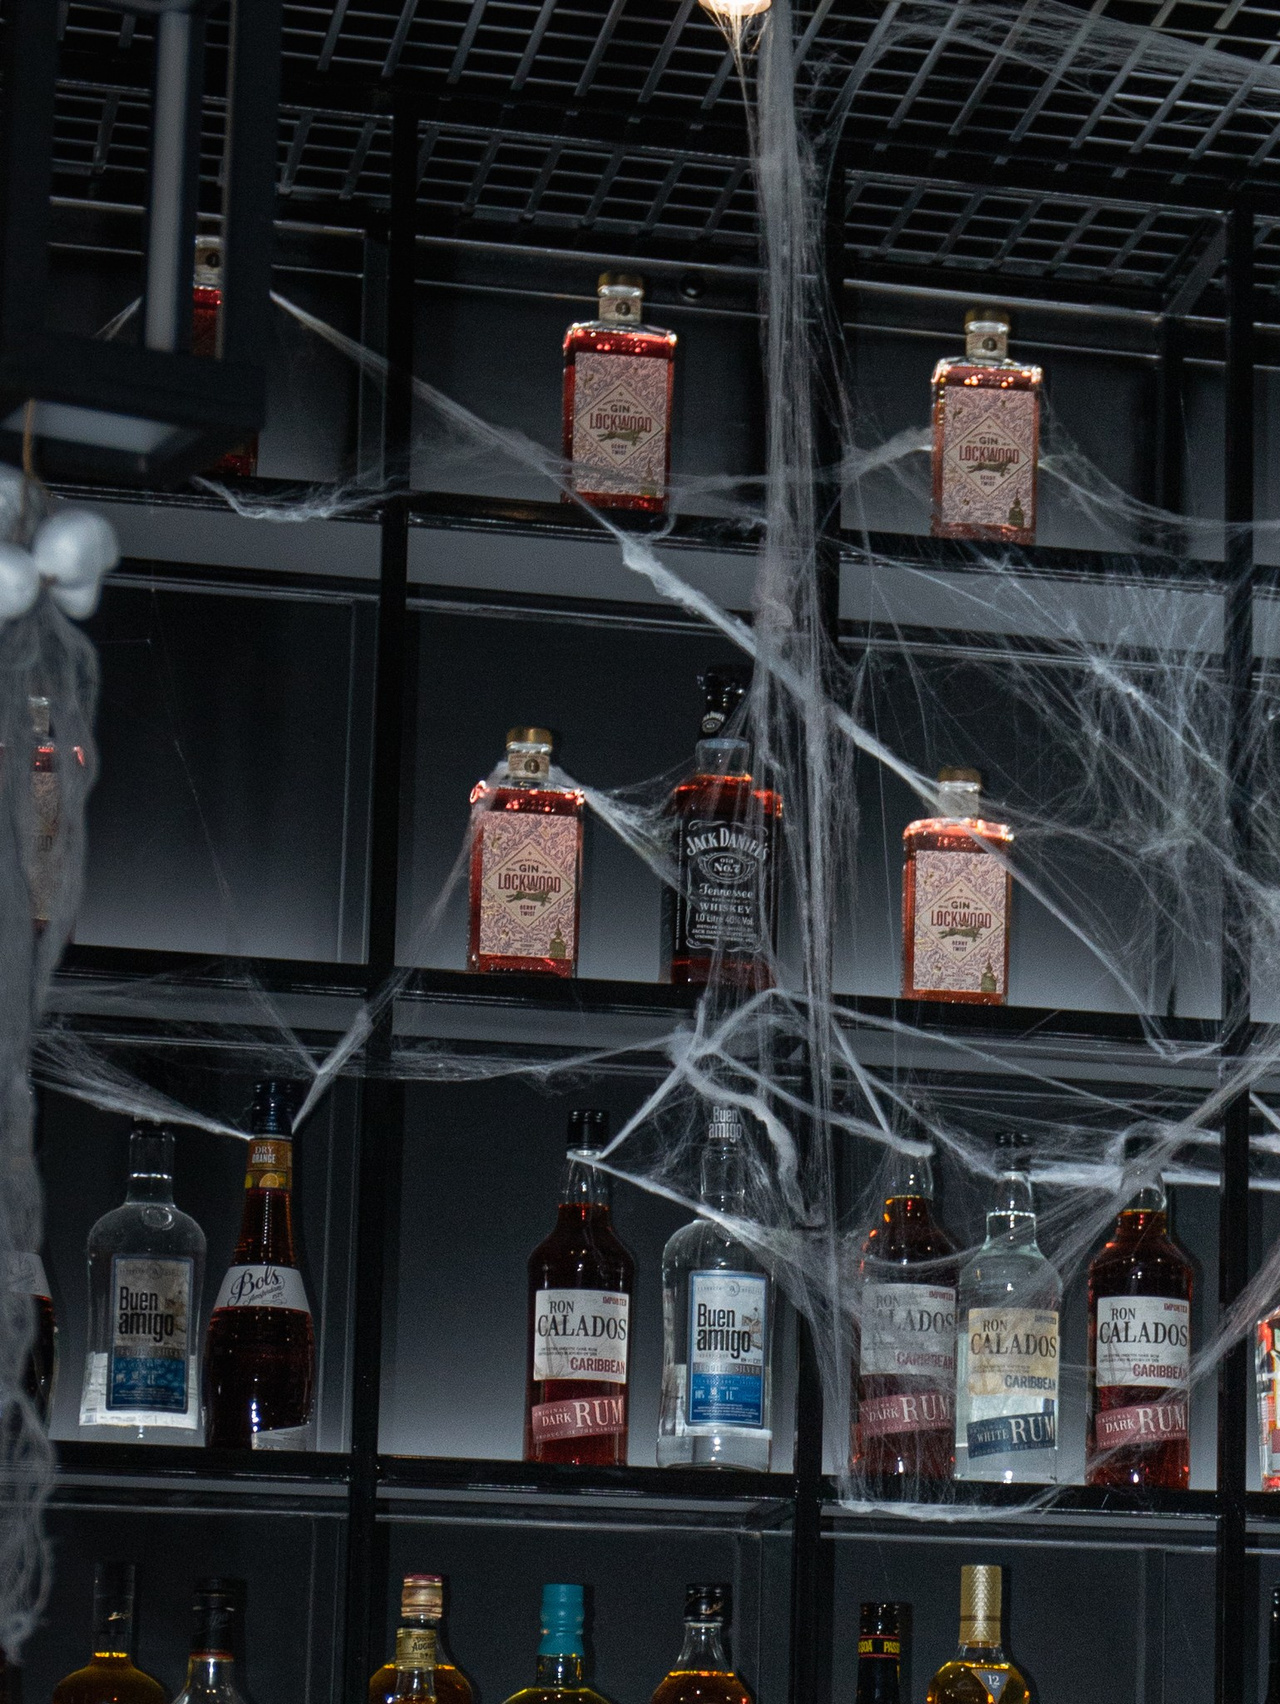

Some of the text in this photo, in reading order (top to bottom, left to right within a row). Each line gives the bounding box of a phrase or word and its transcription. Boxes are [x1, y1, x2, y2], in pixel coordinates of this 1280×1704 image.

[610, 404, 630, 413] GIN
[589, 412, 652, 433] LOCKWOOD
[979, 436, 998, 445] GIN
[959, 445, 1019, 464] LOCKWOOD
[686, 827, 770, 860] JACK DANIEL'S
[518, 864, 539, 873] GIN
[497, 873, 561, 893] LOCKWOOD
[699, 882, 754, 899] Tennessee
[699, 902, 752, 914] WHISKEY
[950, 901, 970, 909] GIN
[931, 910, 992, 929] LOCKWOOD
[252, 1153, 276, 1164] ORANGE
[254, 1145, 275, 1154] DRY
[228, 1266, 285, 1307] Bols
[119, 1286, 158, 1311] Buen
[549, 1300, 575, 1314] RON
[697, 1303, 735, 1328] Buen
[1110, 1307, 1136, 1321] RON
[118, 1311, 174, 1343] amigo
[538, 1314, 627, 1340] CALADOS
[982, 1318, 1008, 1332] RON
[1099, 1321, 1188, 1347] CALADOS
[697, 1328, 751, 1359] amigo
[970, 1332, 1058, 1358] CALADOS
[570, 1357, 626, 1375] CARIBBEAN
[735, 1365, 760, 1374] SILVER
[896, 1352, 954, 1370] CARIBBEAN
[1132, 1363, 1187, 1380] CARIBBEA
[1004, 1374, 1056, 1391] CARIBBEAN
[542, 1399, 624, 1428] DARK RUM
[1105, 1405, 1186, 1434] DARK RUM
[976, 1427, 1009, 1442] WHITE
[987, 1675, 1000, 1685] 12
